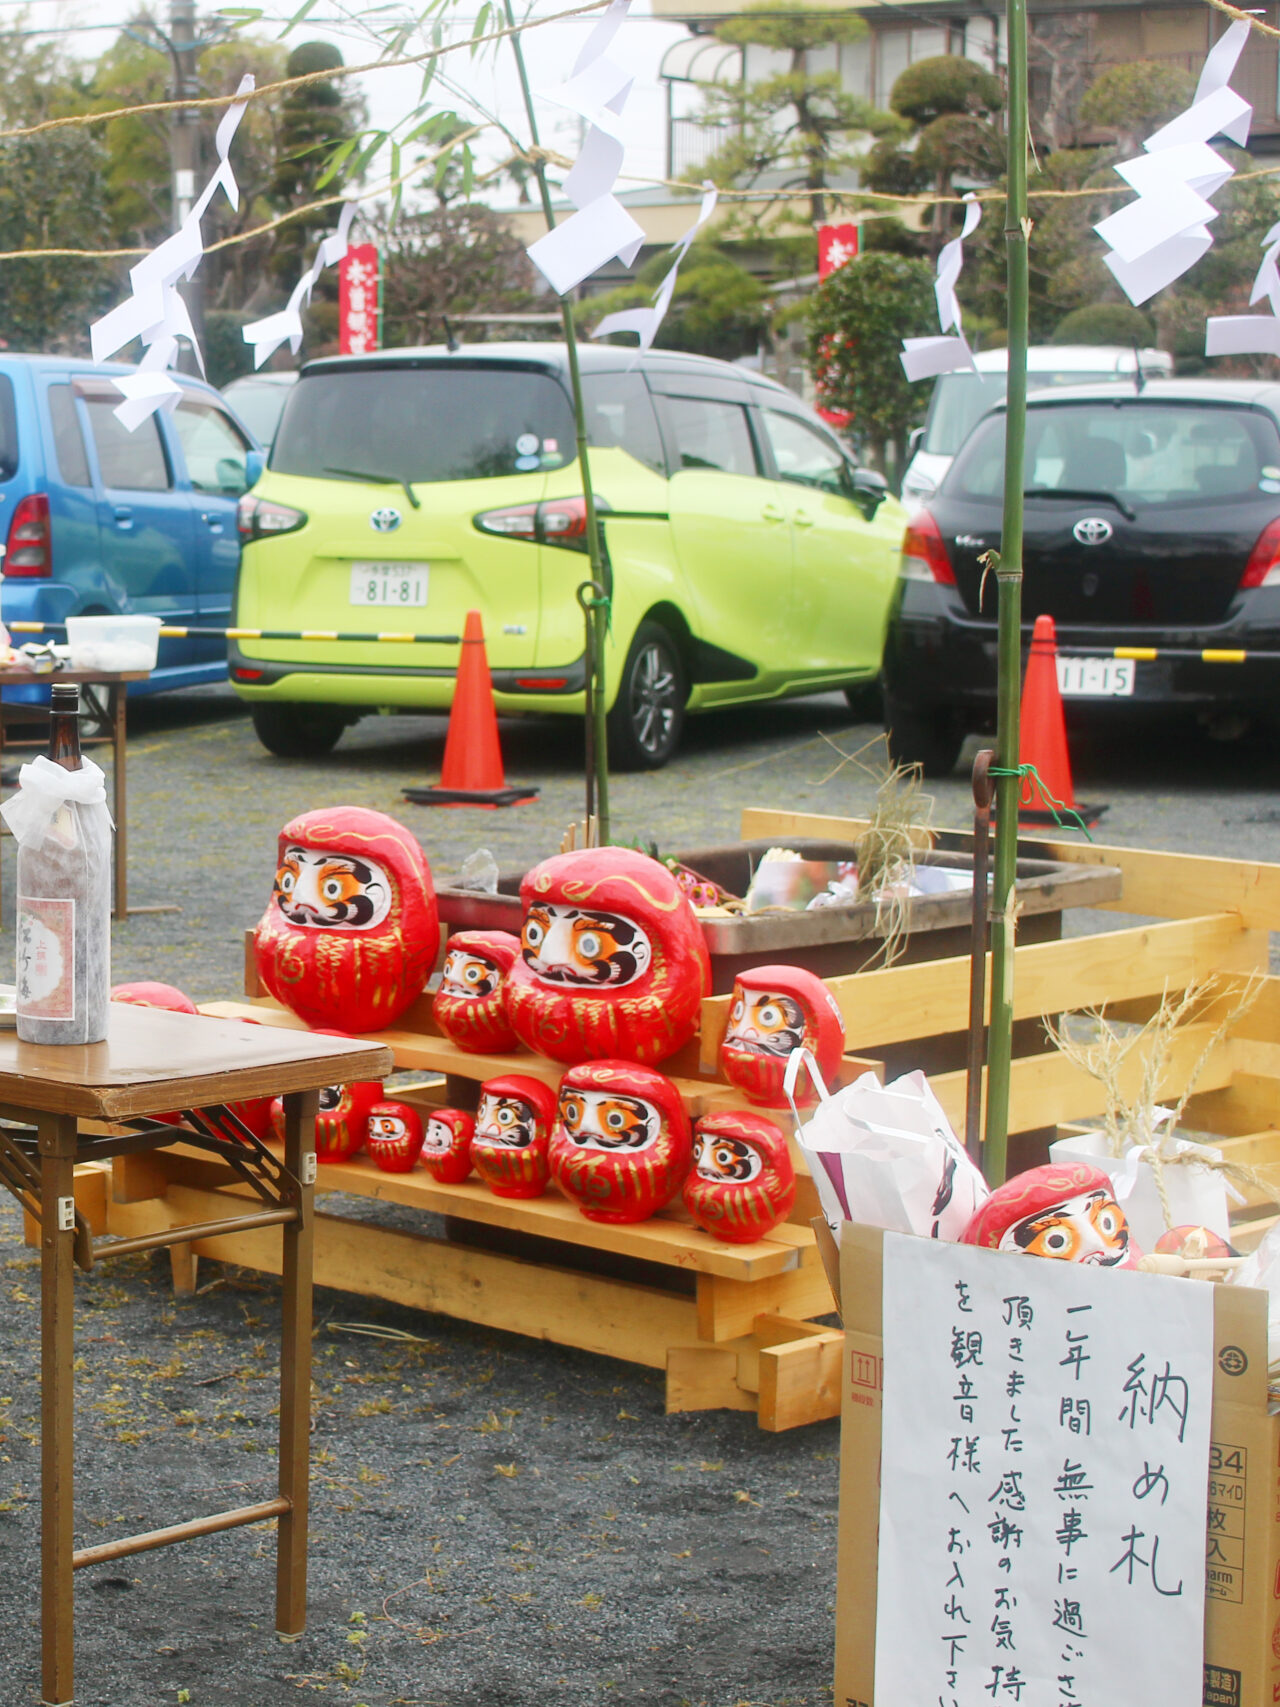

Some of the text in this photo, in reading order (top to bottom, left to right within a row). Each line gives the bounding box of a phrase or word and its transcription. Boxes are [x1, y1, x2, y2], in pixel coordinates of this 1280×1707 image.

[366, 580, 421, 602] 81-81
[1064, 667, 1128, 690] 11-15
[1110, 1354, 1188, 1595] 納め札
[1053, 1306, 1093, 1707] 一年間無事に過ごさ
[1206, 1667, 1238, 1694] 製造)
